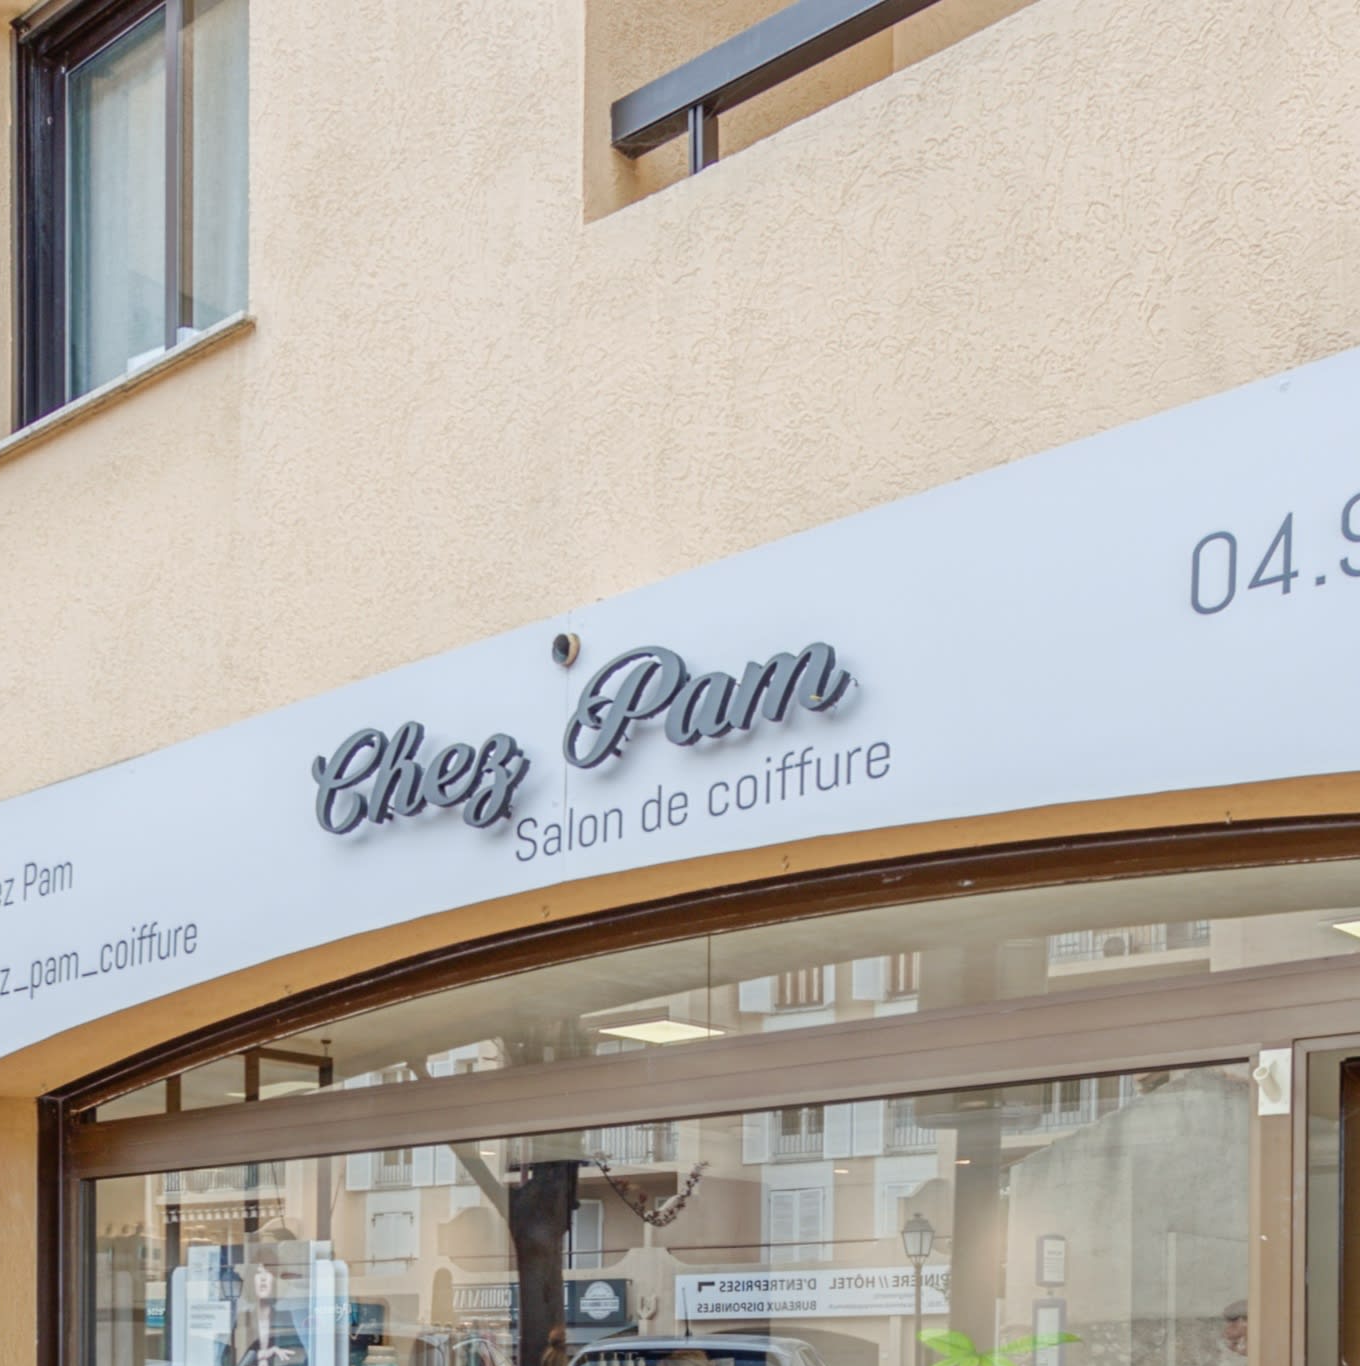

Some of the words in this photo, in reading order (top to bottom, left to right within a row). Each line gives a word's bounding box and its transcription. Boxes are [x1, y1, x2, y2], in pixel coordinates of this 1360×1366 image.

[311, 719, 532, 836] Chez
[562, 641, 858, 770] Pam
[514, 806, 624, 862] Salon
[641, 783, 689, 832] de
[706, 740, 891, 818] coiffure
[22, 857, 74, 906] Pam
